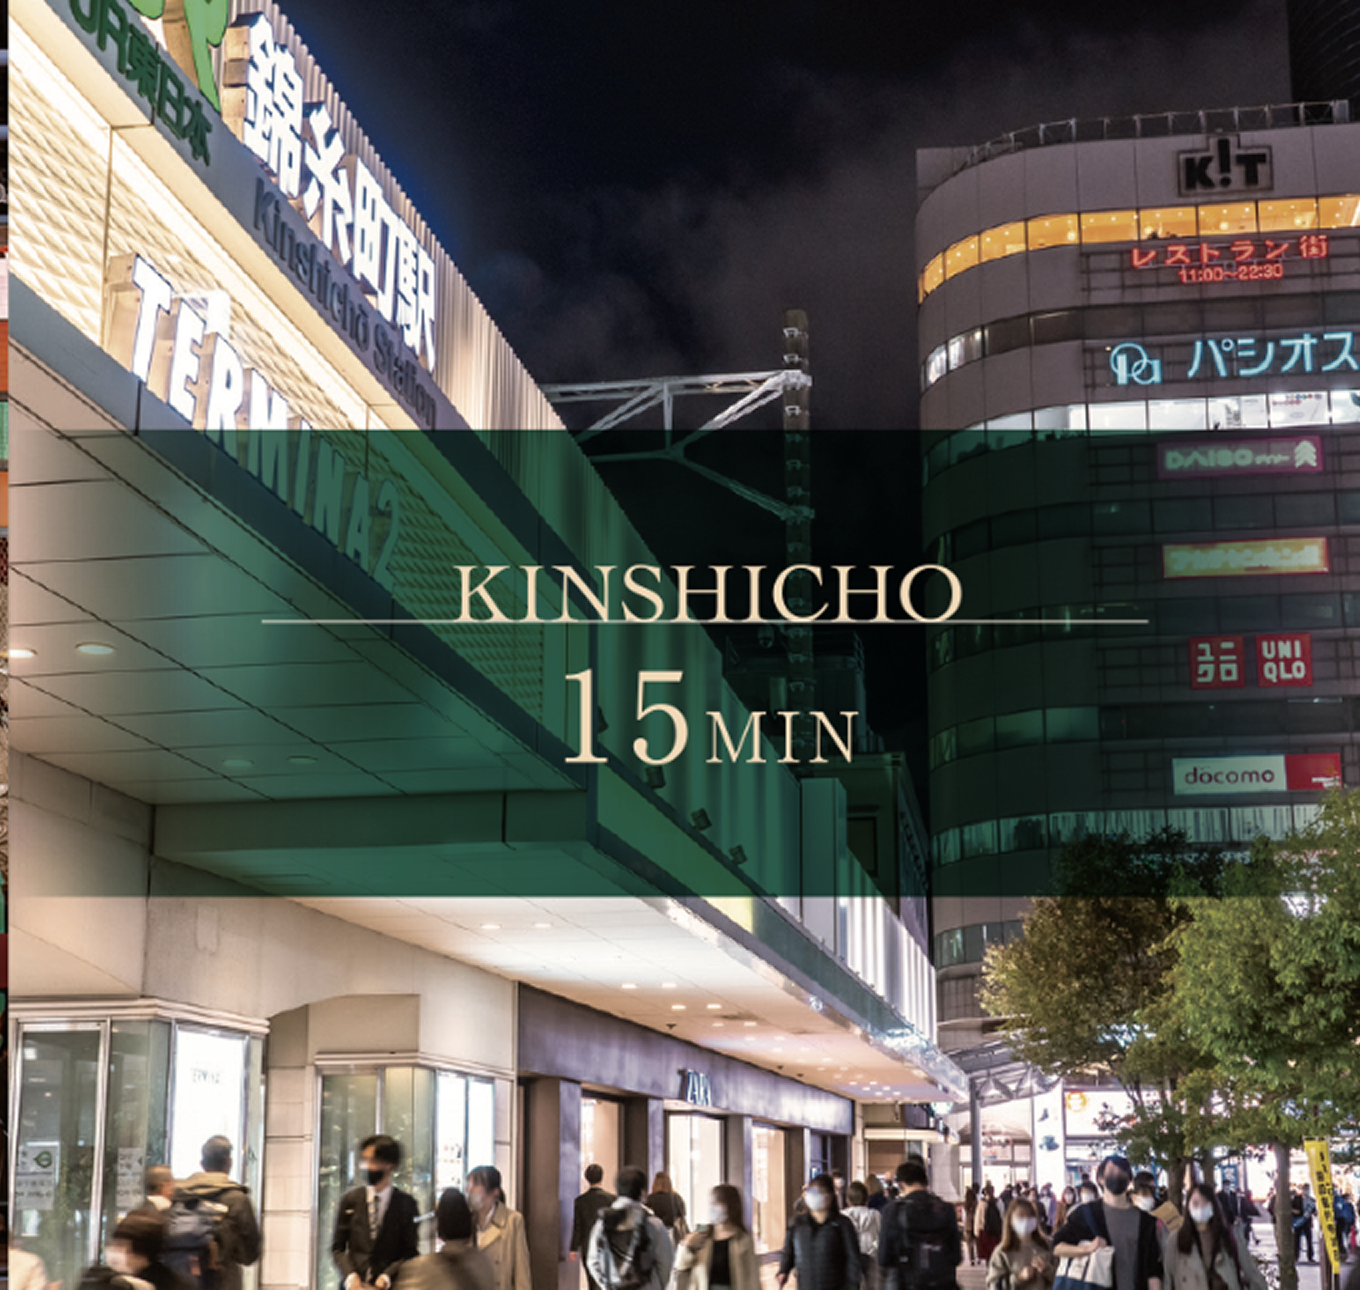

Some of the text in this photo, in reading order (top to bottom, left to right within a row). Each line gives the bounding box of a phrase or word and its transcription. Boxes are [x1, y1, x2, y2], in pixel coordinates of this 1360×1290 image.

[243, 11, 436, 374] 錦糸町駅
[1132, 234, 1328, 268] レストラン街
[1187, 331, 1360, 378] パシオス
[373, 322, 437, 430] Station
[1165, 449, 1254, 470] DAISO
[1185, 766, 1275, 786] docomo
